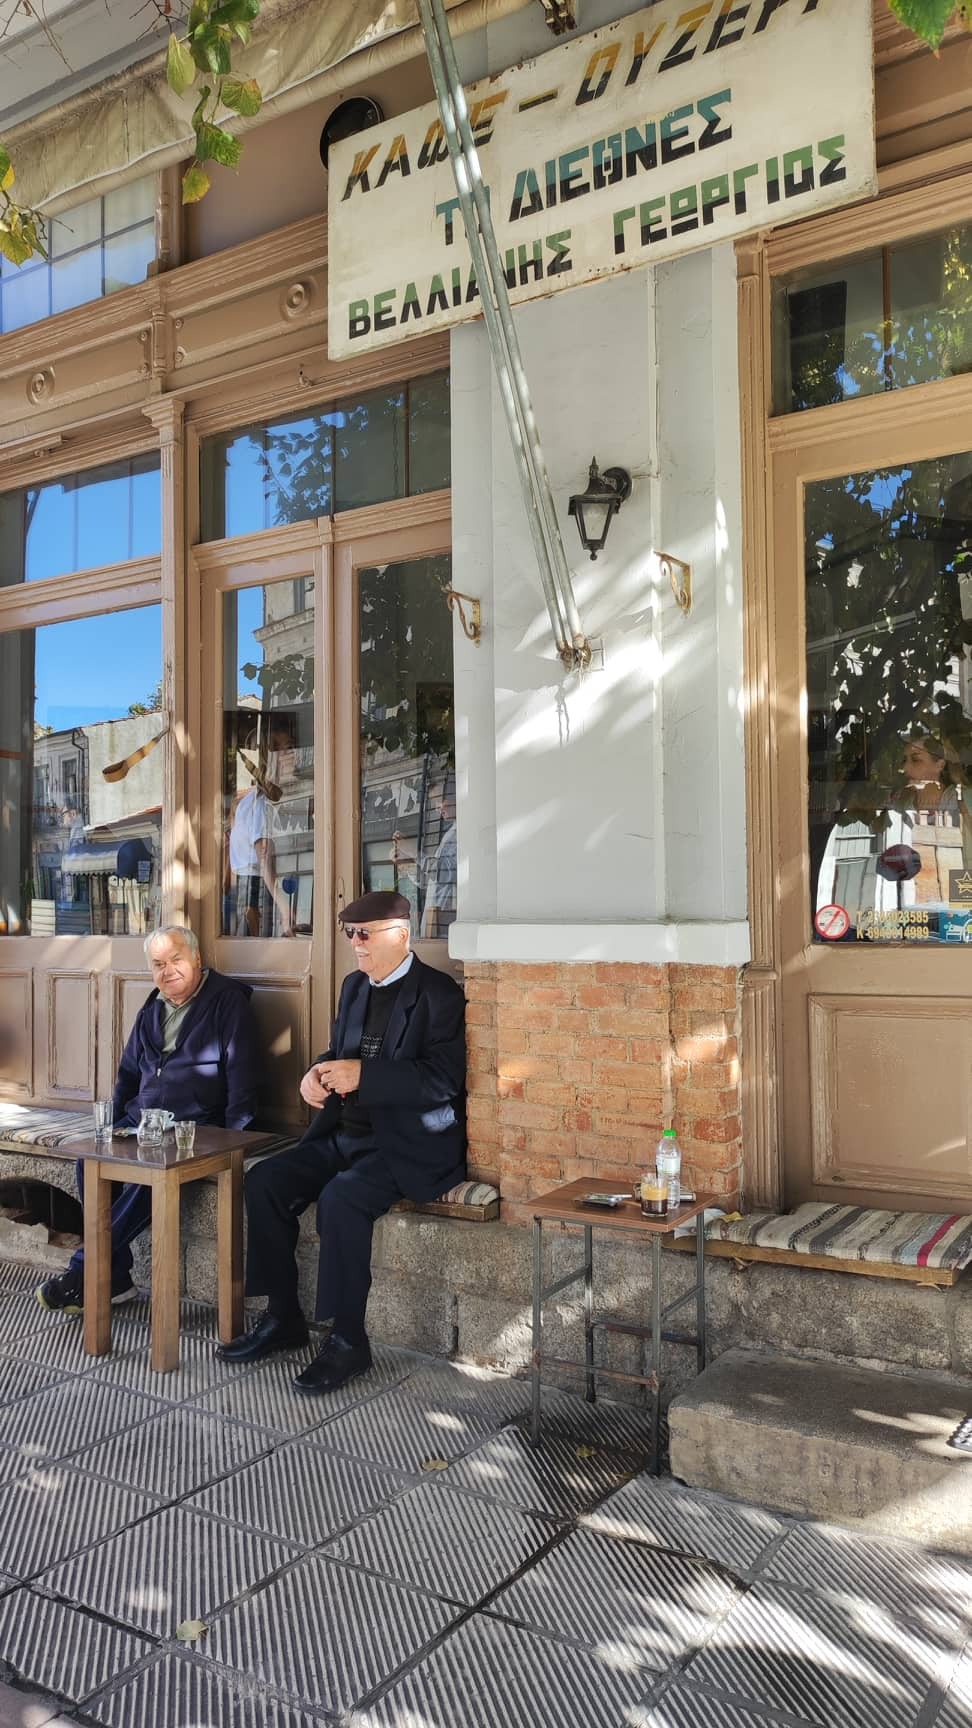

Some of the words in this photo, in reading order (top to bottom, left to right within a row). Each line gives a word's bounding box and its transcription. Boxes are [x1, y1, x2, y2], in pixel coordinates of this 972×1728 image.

[575, 0, 819, 106] ΟΥΖΕΡ
[436, 186, 491, 246] Τ
[612, 134, 848, 256] ΓΕΩΡΓΙΟΣ
